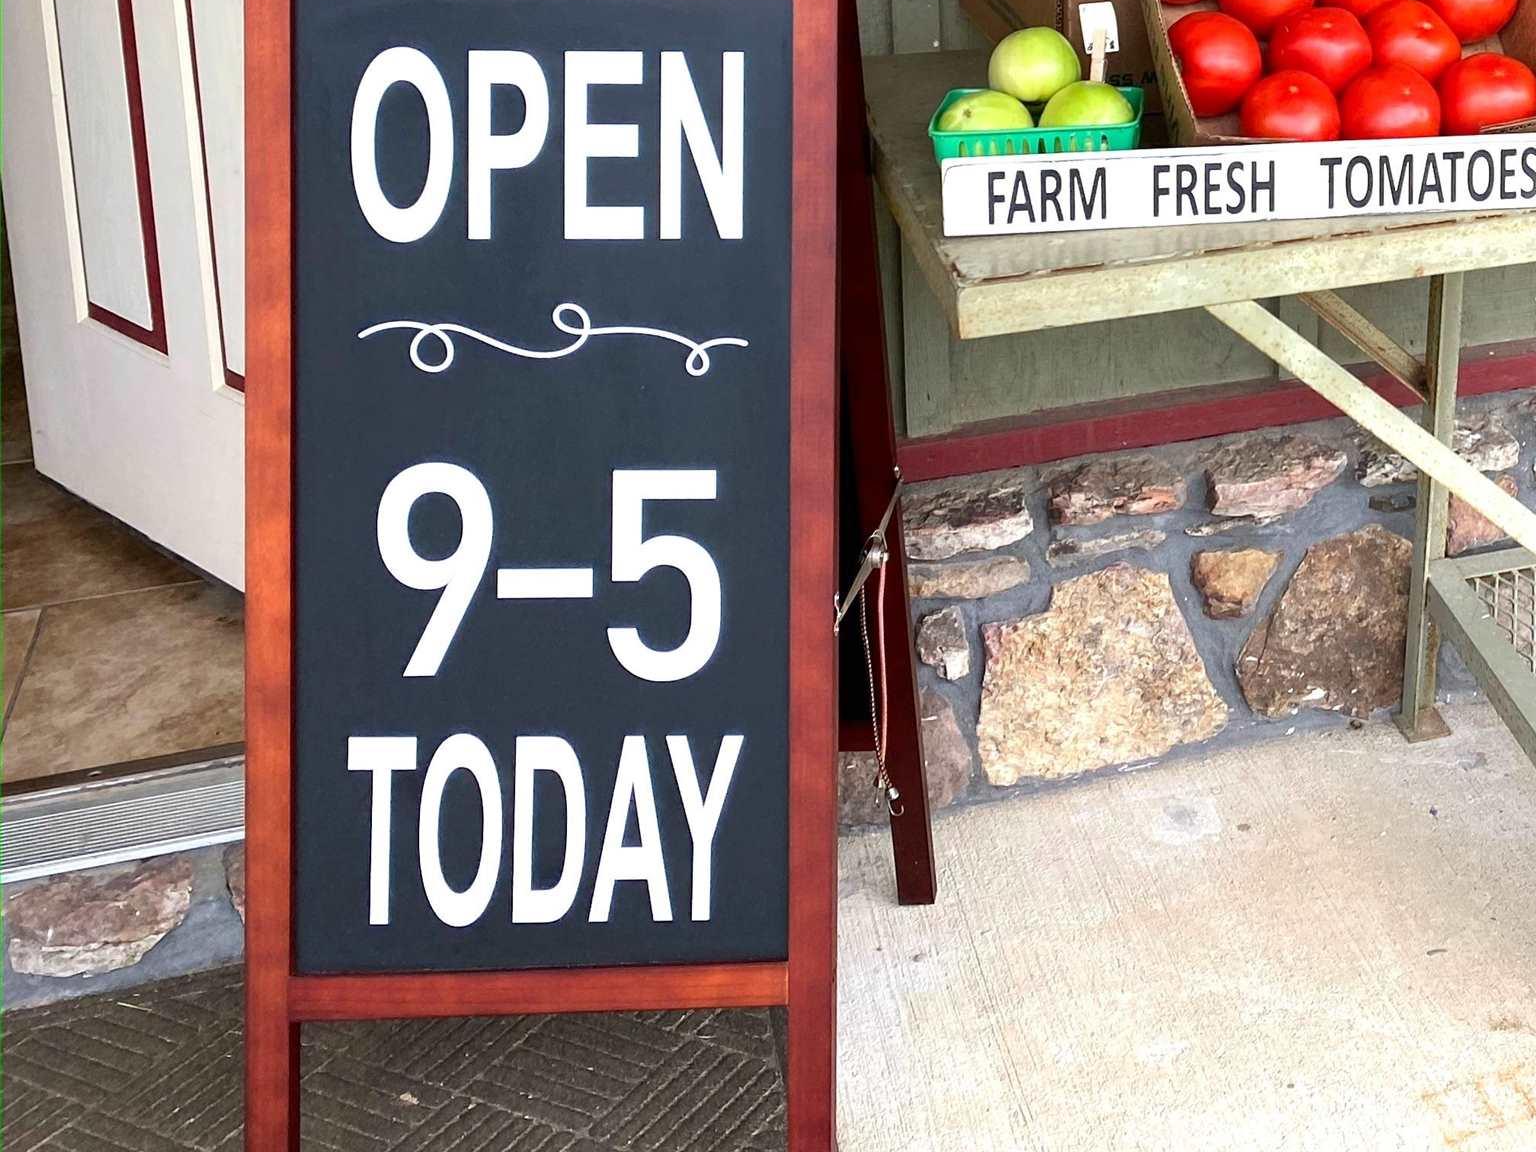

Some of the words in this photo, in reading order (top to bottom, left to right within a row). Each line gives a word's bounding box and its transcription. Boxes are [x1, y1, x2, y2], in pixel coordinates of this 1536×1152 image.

[351, 46, 745, 243] OPEN
[987, 166, 1108, 225] FARM
[1152, 159, 1276, 218] FRESH
[376, 460, 722, 682] 9-5
[347, 732, 745, 927] TODAY
